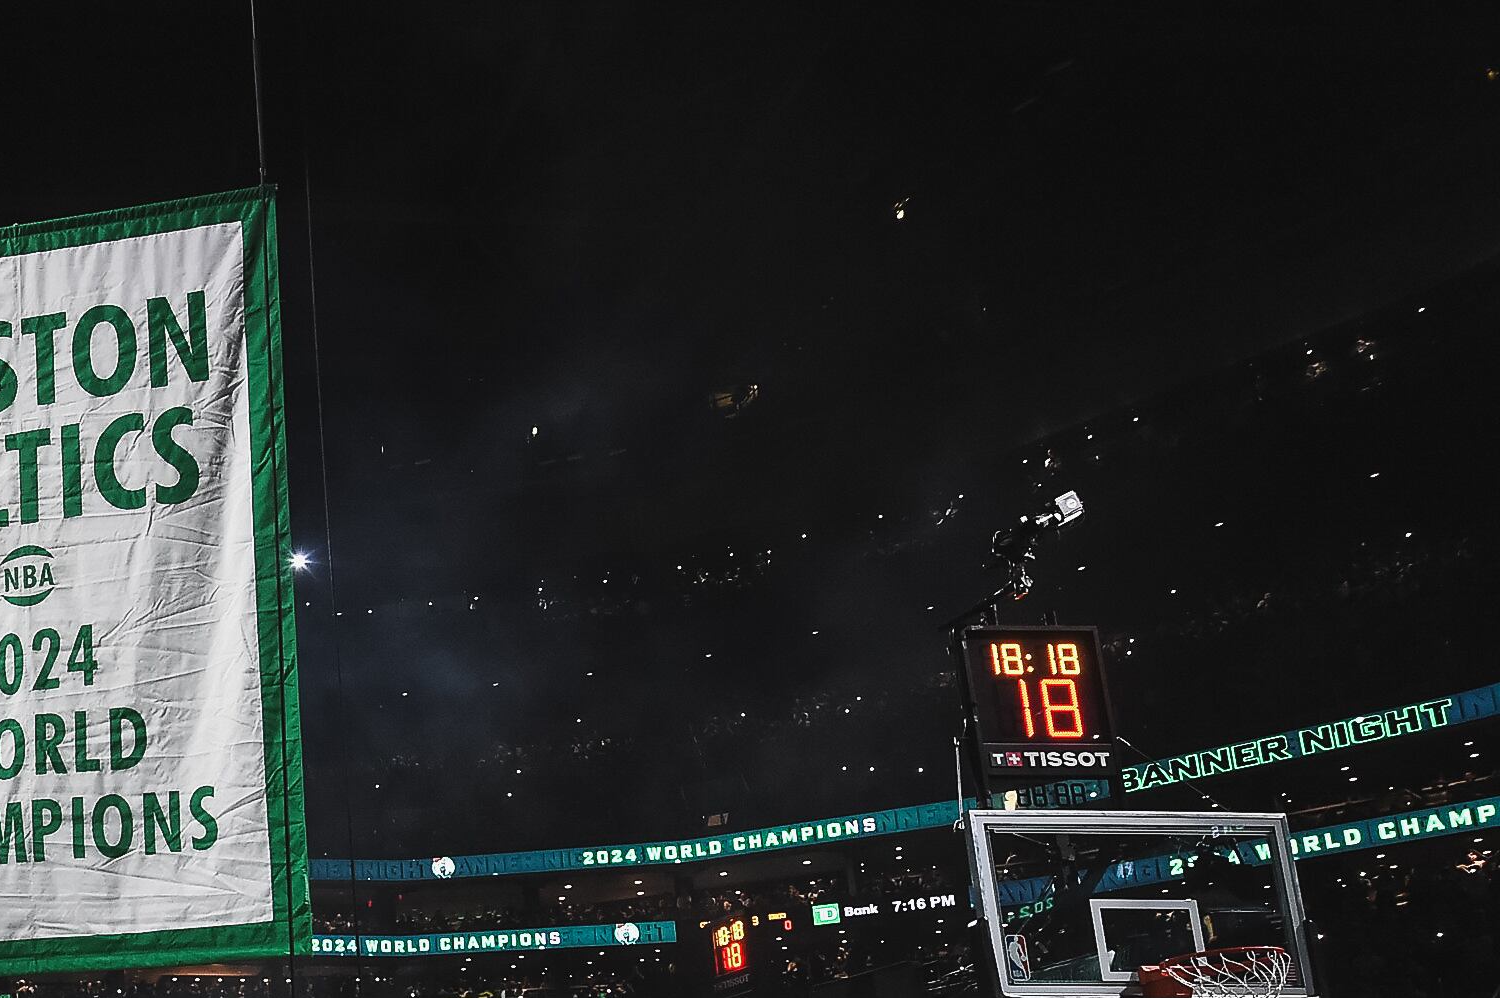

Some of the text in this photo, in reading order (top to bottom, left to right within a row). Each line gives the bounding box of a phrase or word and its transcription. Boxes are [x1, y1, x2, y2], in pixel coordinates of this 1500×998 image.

[4, 561, 55, 590] NBA
[990, 643, 1081, 675] 18:18
[1018, 678, 1084, 738] 18
[1024, 751, 1110, 767] TISSOT
[1122, 736, 1293, 792] BANNER
[1299, 699, 1452, 755] NIGHT
[1377, 805, 1496, 840] CHAMP
[582, 848, 637, 865] 2024
[647, 840, 722, 861] WORLD
[733, 817, 877, 852] CHAMPIONS
[815, 895, 956, 922] TD Bank 7:16 PM
[312, 938, 357, 952] 2024
[365, 939, 430, 953] WORLD
[439, 932, 561, 950] CHAMPIONS
